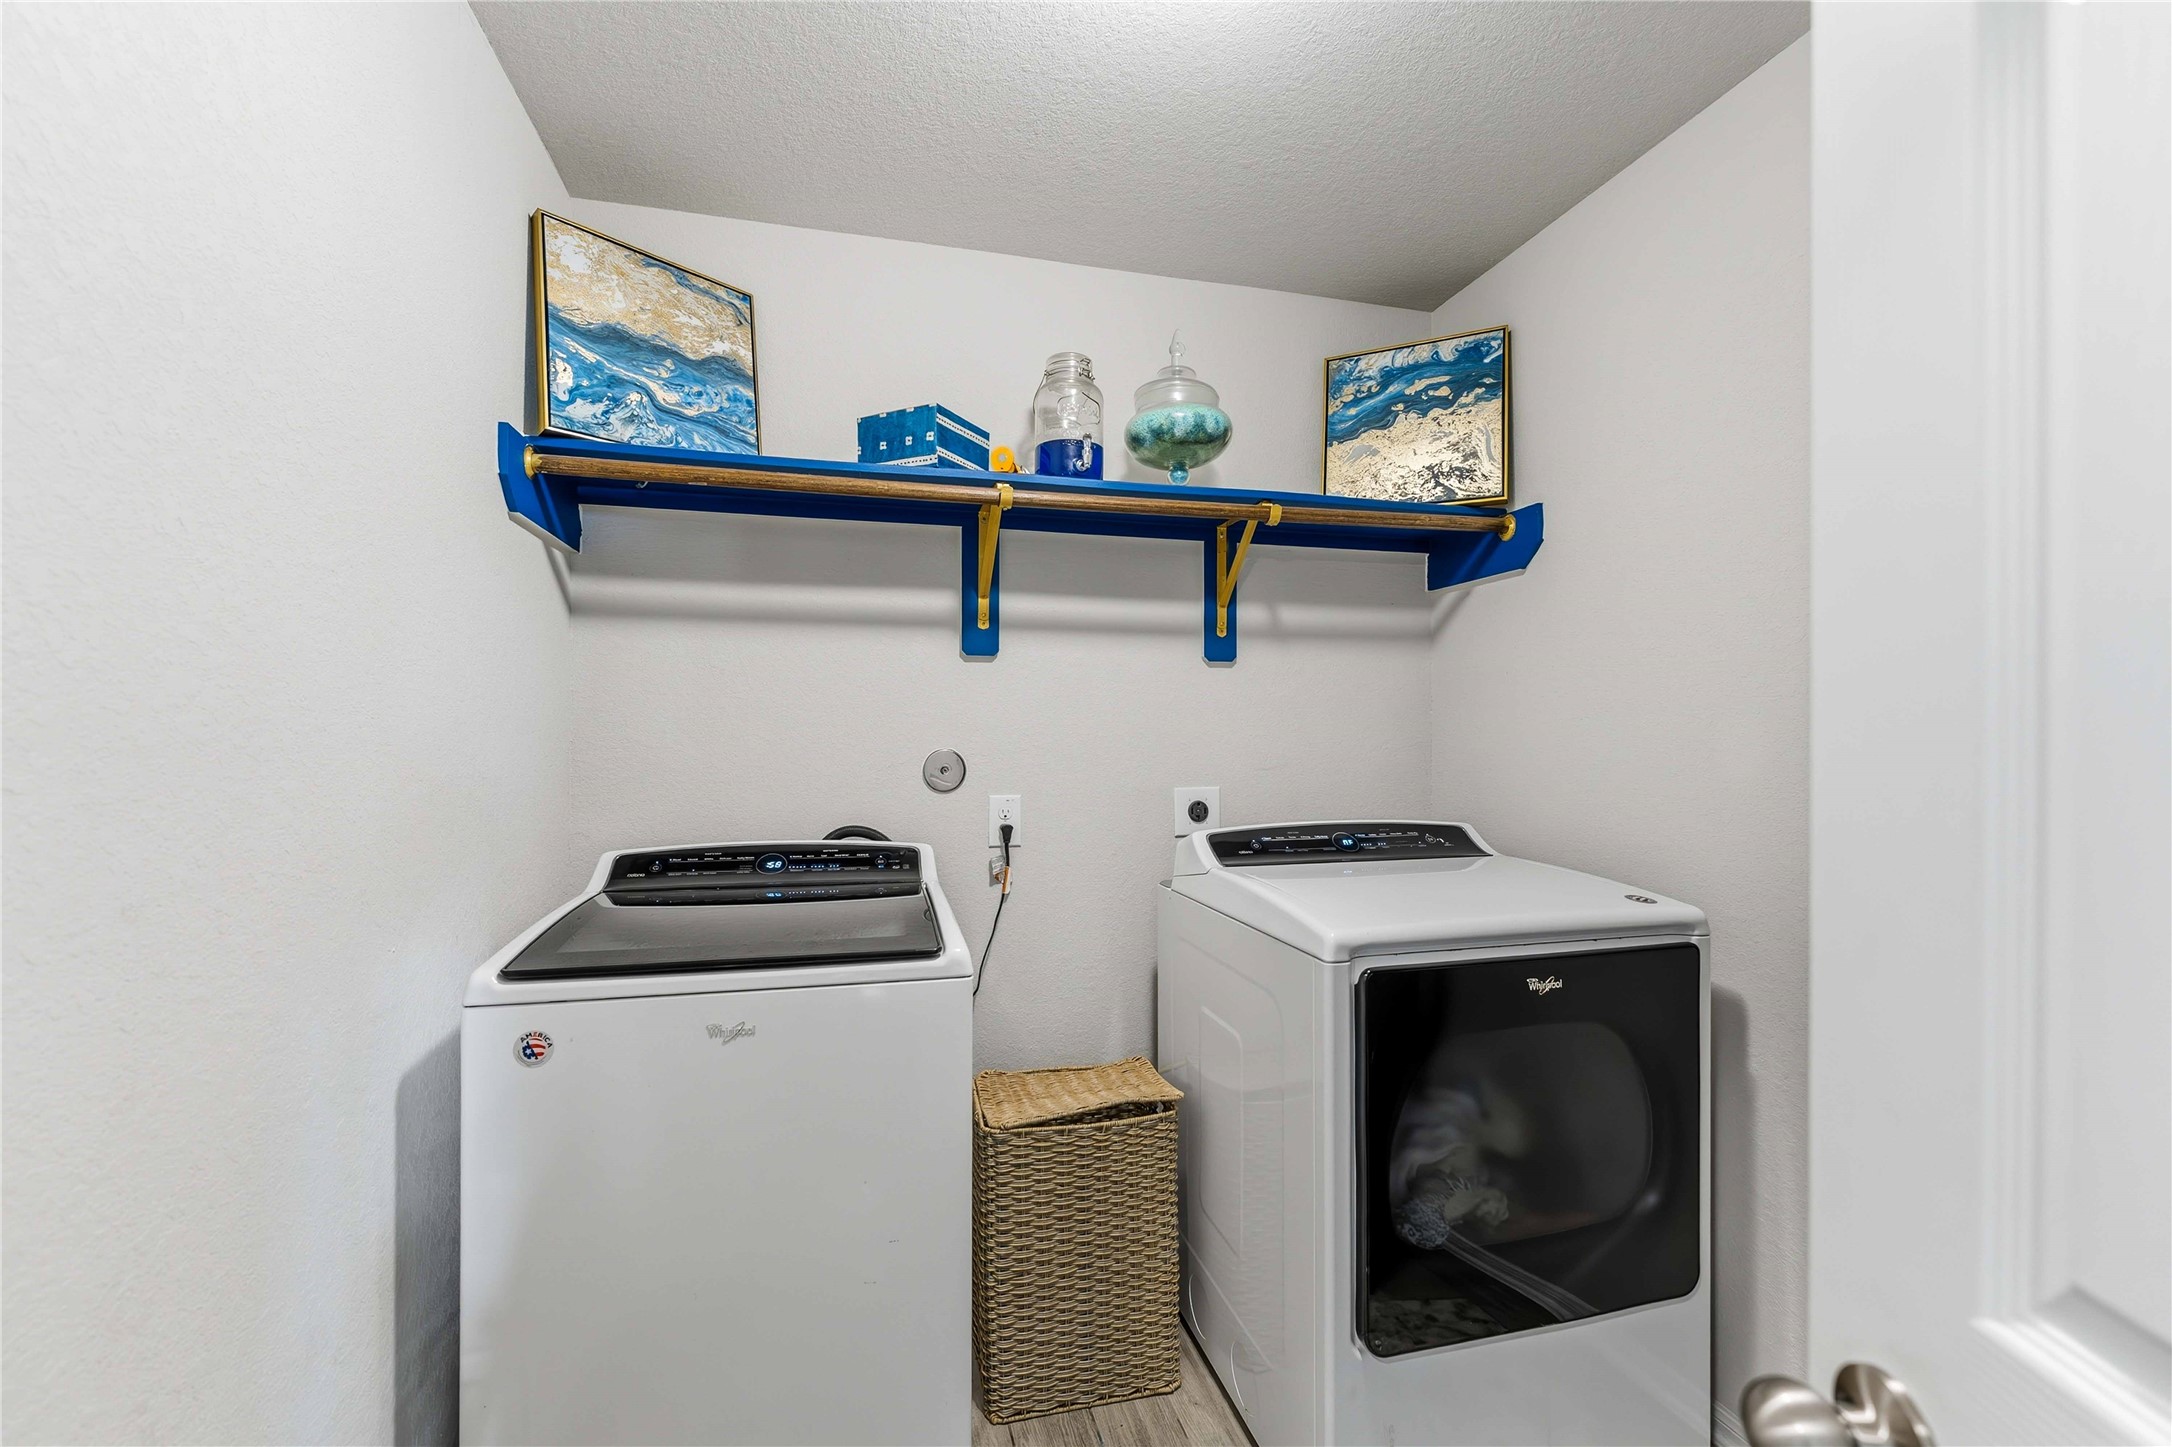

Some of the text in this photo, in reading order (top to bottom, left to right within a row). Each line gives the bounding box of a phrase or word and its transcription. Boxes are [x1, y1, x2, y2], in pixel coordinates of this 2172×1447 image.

[1526, 975, 1563, 996] Whirlpool
[520, 1031, 553, 1049] AMERICA
[705, 1021, 756, 1046] Whirlpool
